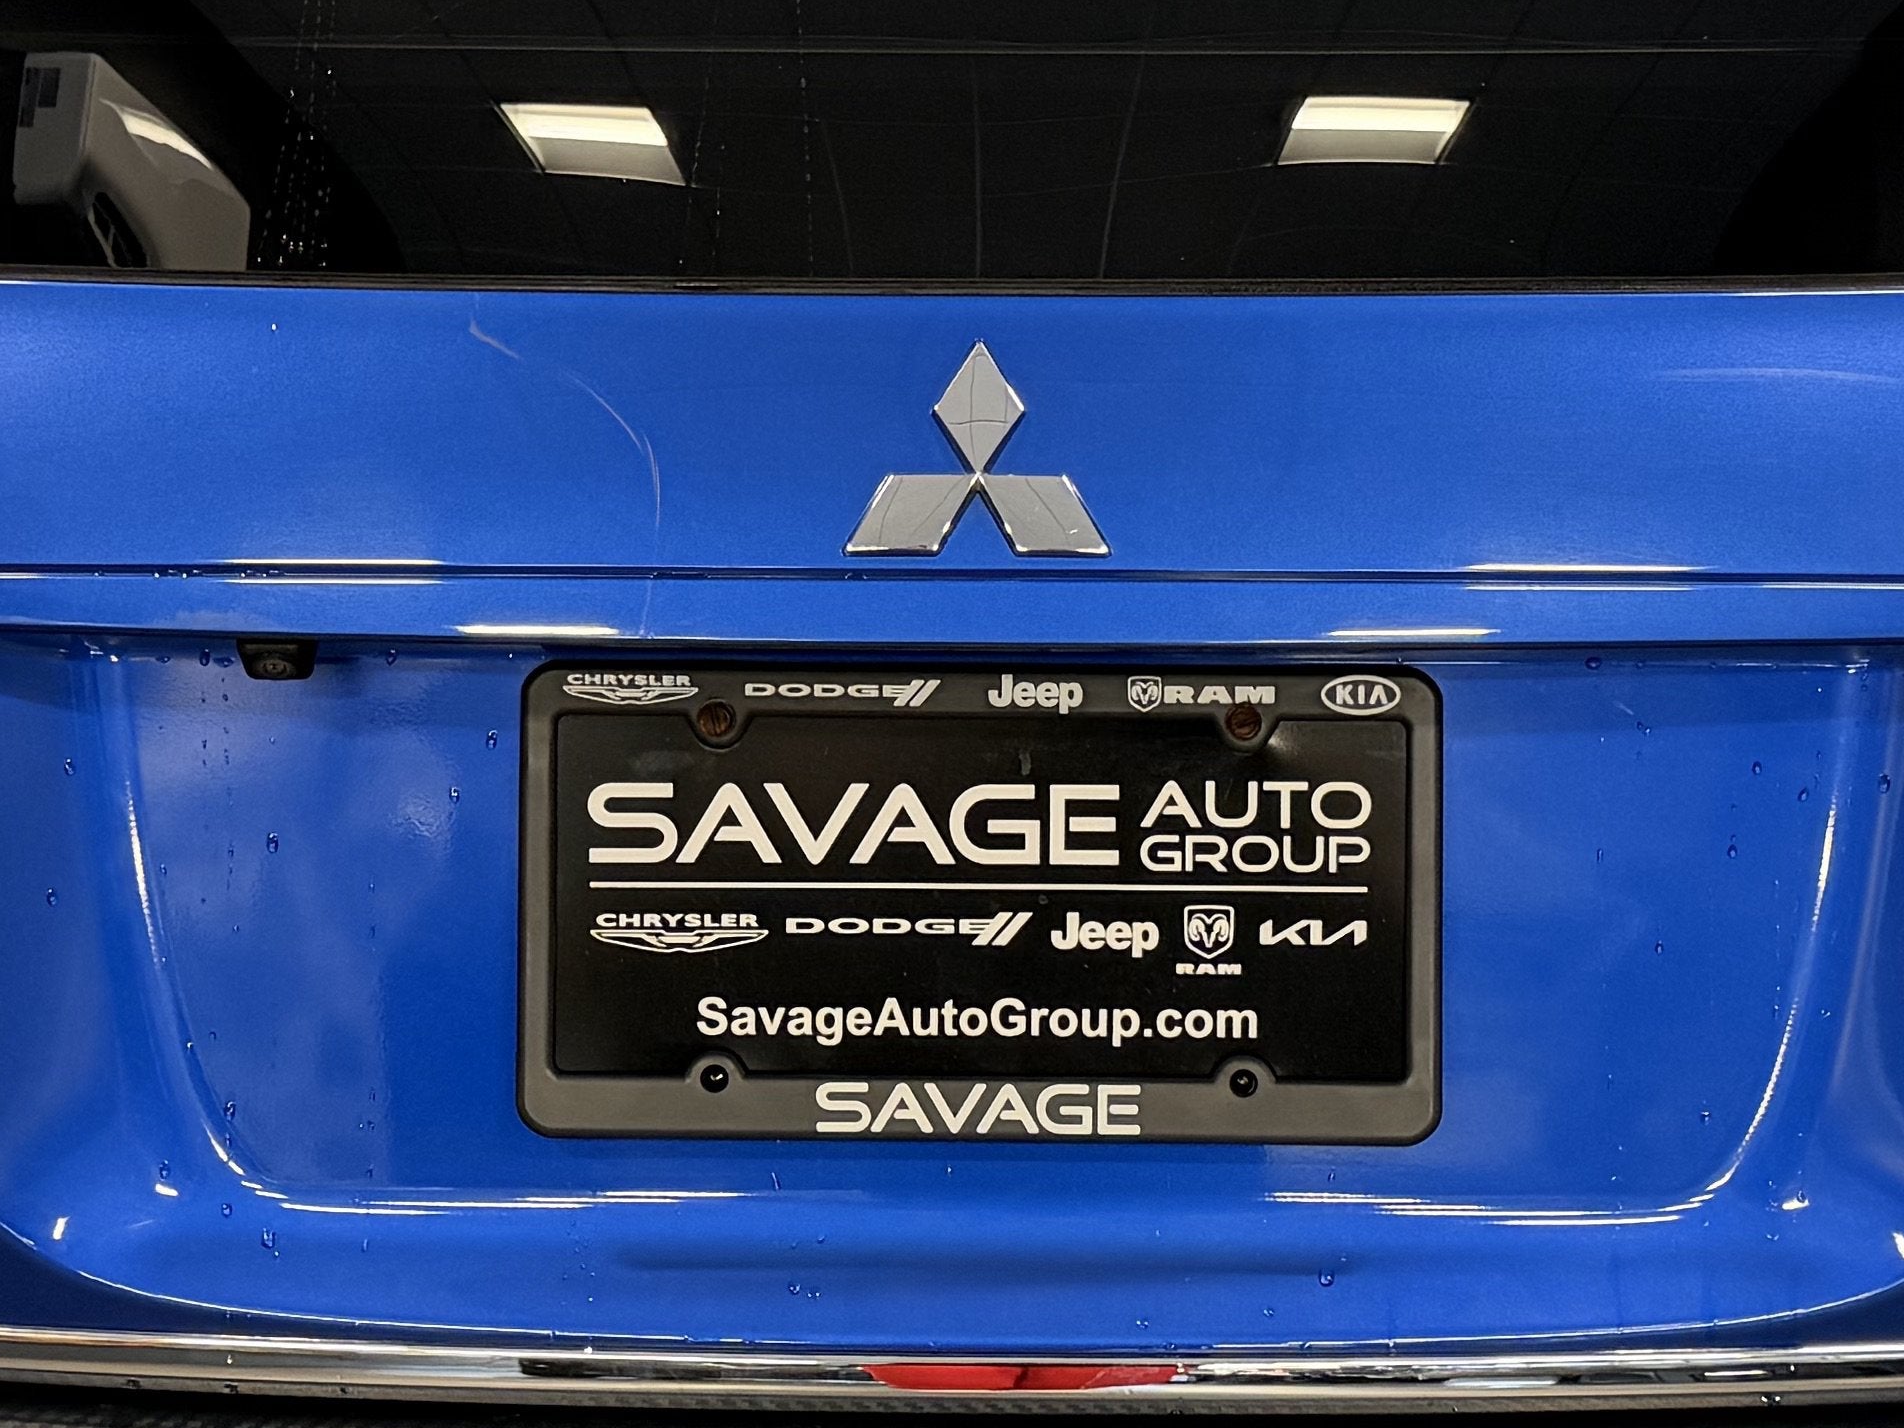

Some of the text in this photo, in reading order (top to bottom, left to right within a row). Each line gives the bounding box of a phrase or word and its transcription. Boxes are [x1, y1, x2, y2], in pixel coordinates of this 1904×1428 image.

[567, 673, 1388, 714] CHRYSLER DODGE Jeep RAM KIA
[588, 780, 1372, 865] SAVAGE AUTO
[1140, 834, 1371, 873] GROUP
[596, 912, 1368, 958] CHRYSLER DODGE Jeep KIA
[1176, 963, 1242, 975] RAM
[696, 996, 1258, 1047] SavageAutoGroup.com
[815, 1081, 1141, 1136] SAVAGE
